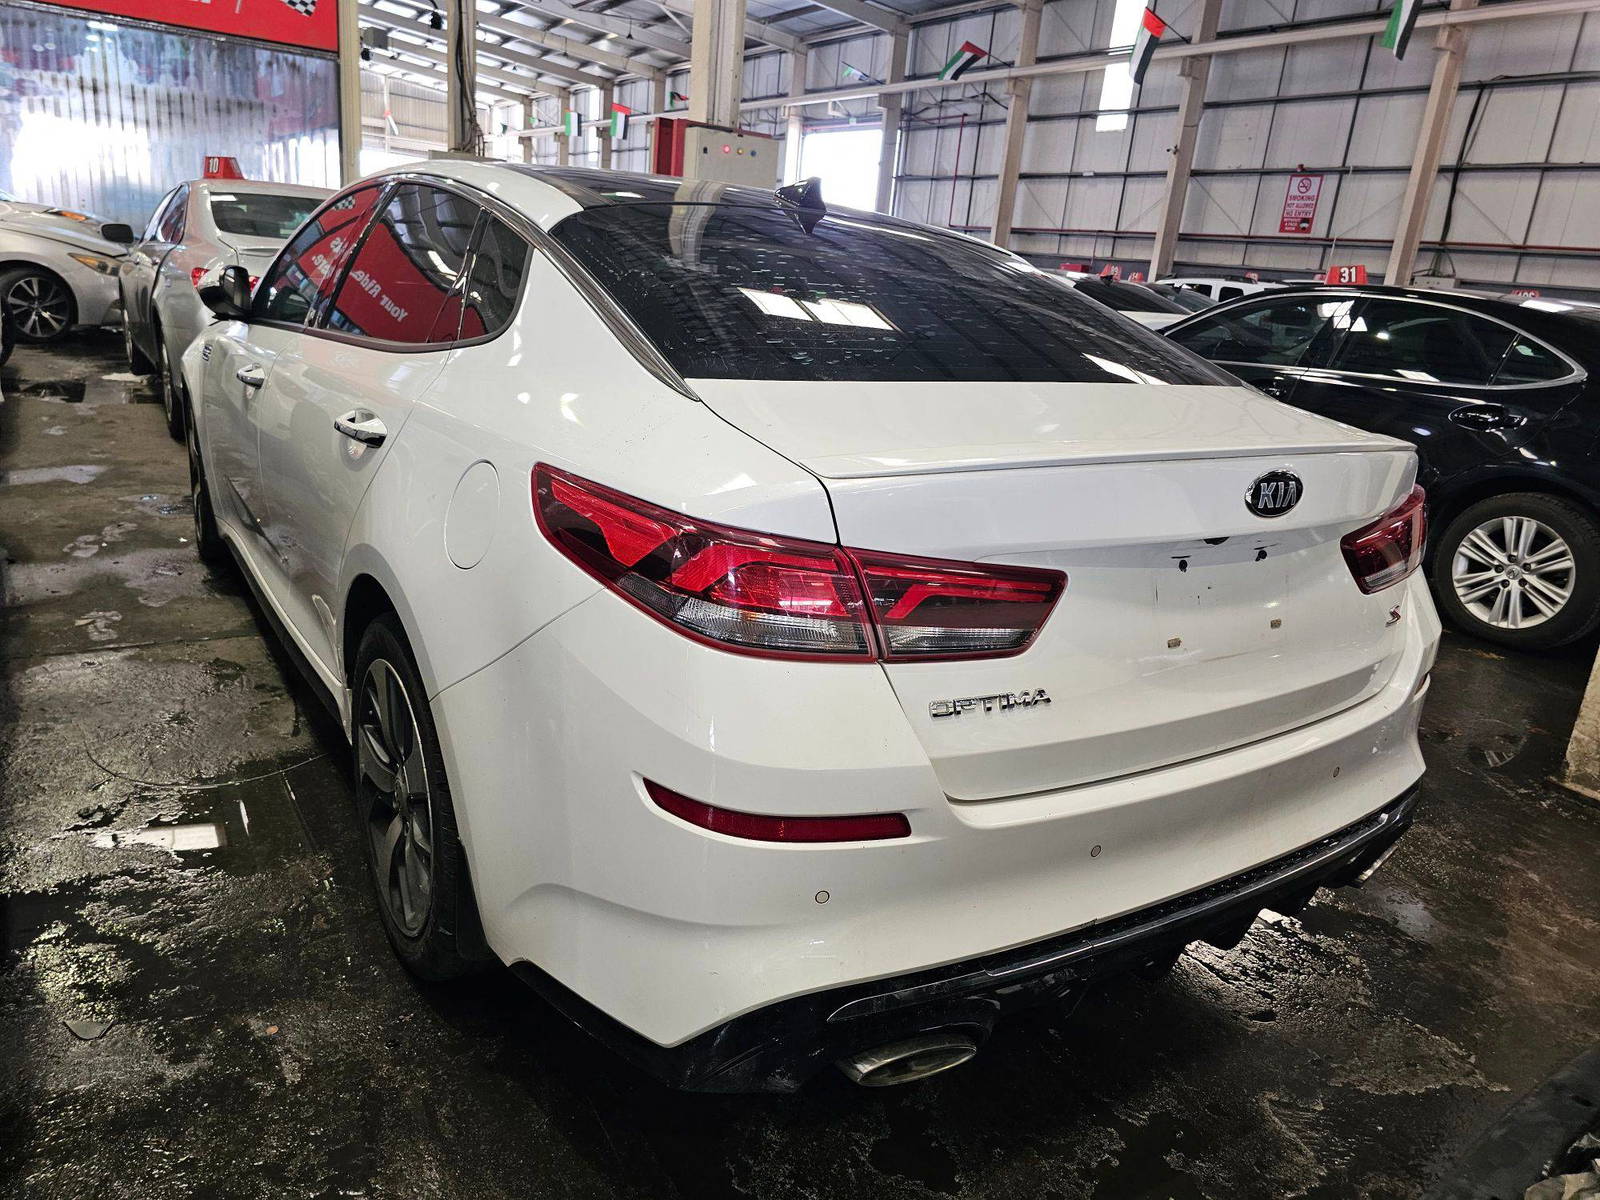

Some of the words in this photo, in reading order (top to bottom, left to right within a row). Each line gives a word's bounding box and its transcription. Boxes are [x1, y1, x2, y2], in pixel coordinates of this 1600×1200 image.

[209, 157, 219, 174] 10
[1289, 194, 1316, 202] SMOKING
[1340, 266, 1356, 283] 31
[1258, 481, 1297, 508] KIA
[1384, 604, 1401, 628] S
[928, 688, 1051, 718] OPTIMA
